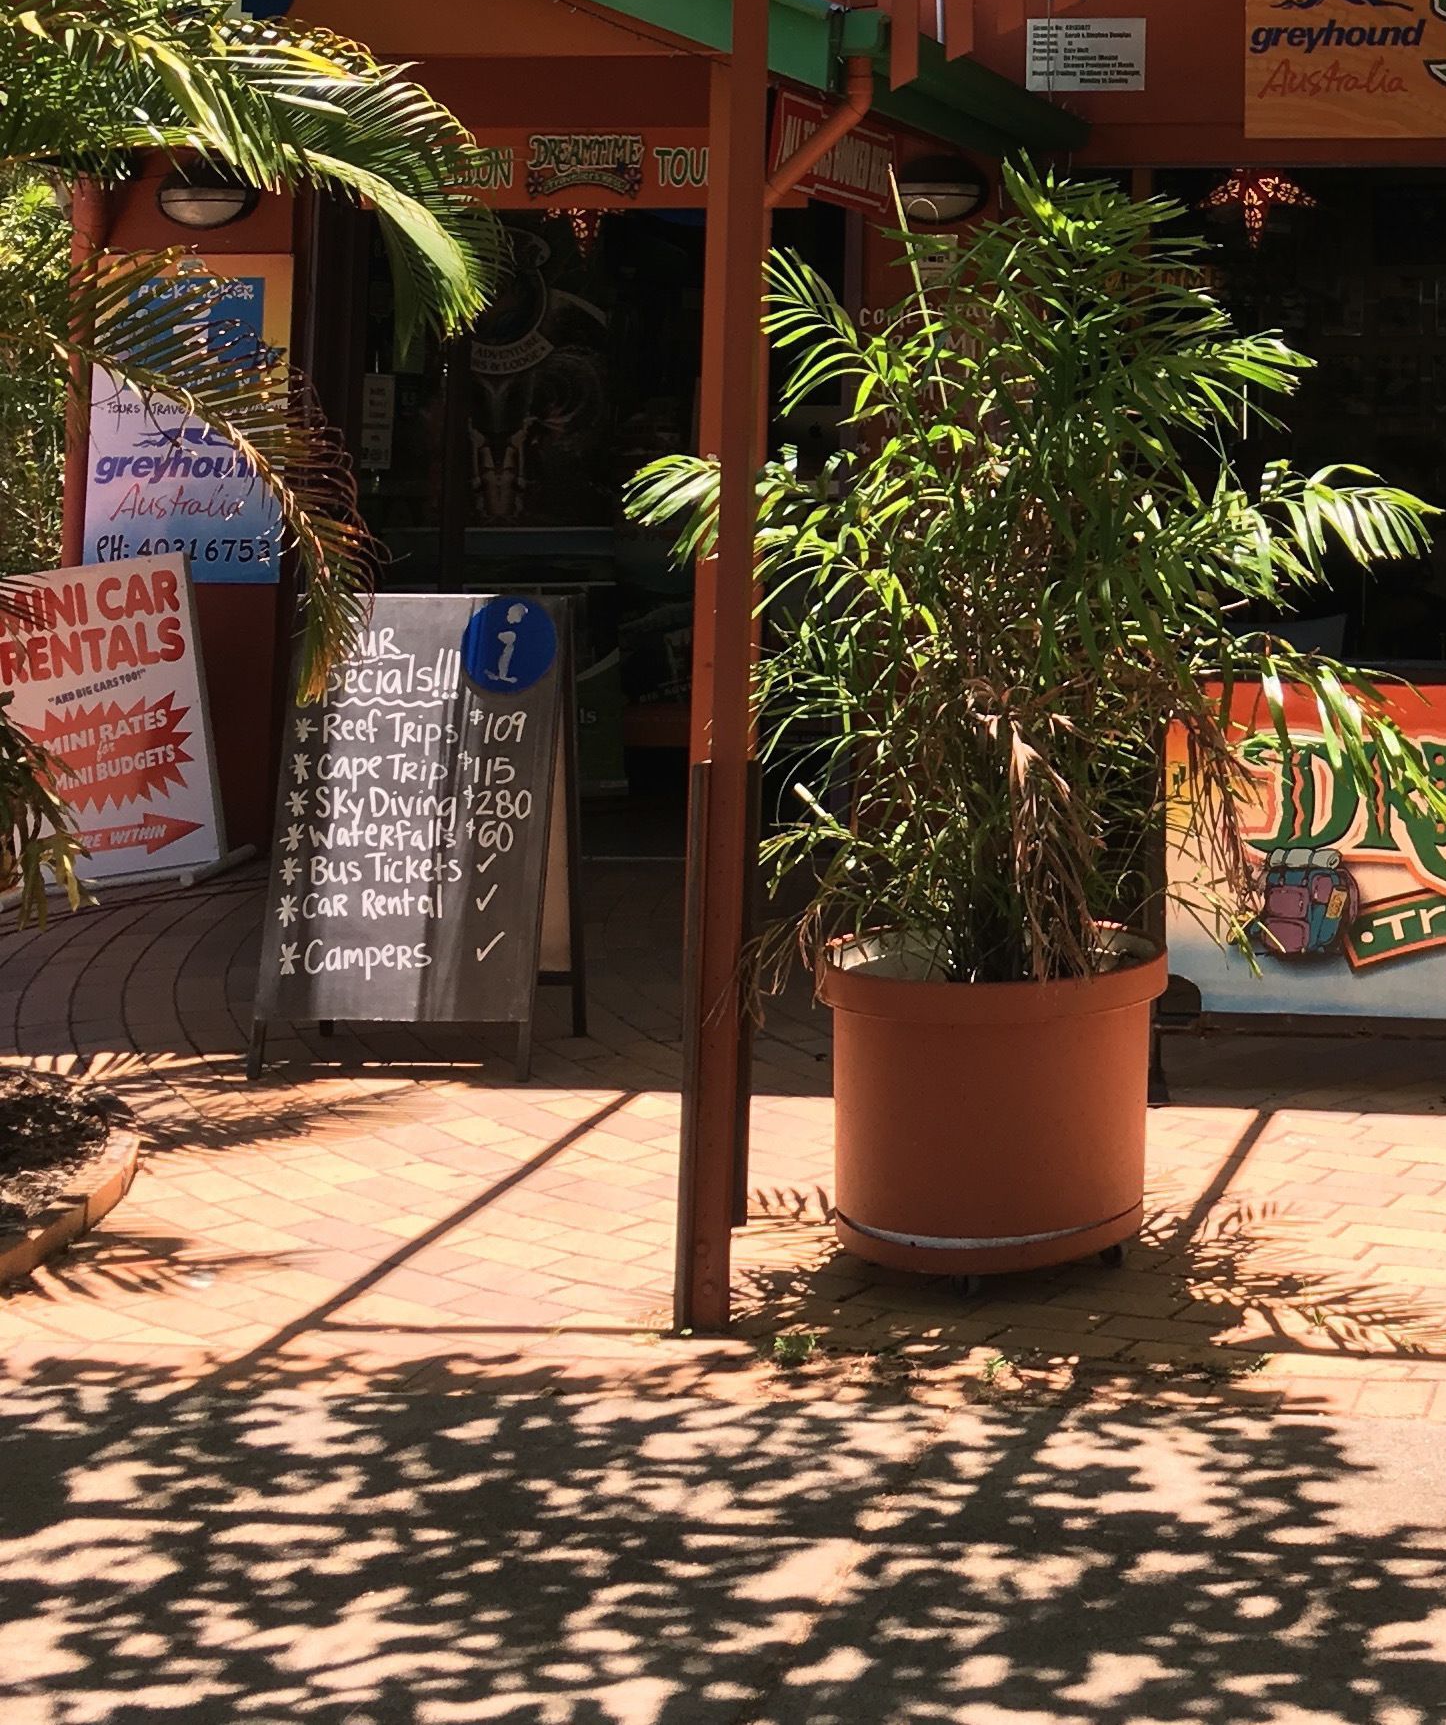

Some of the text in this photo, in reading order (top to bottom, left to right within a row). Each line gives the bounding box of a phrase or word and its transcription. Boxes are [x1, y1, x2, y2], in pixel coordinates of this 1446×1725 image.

[1250, 19, 1426, 54] greyhound
[1258, 56, 1408, 99] Australia
[527, 134, 643, 176] DREAMTIME
[653, 147, 710, 188] TOU
[107, 402, 187, 415] TOURS TRAVE
[110, 482, 244, 521] Australia
[96, 569, 180, 620] CAR
[0, 616, 185, 686] RENTALS
[76, 684, 93, 697] BIG
[94, 677, 118, 692] CARS
[297, 648, 461, 708] pecials!!!
[43, 708, 168, 756] MINI RATES
[322, 708, 382, 744] Reef
[470, 710, 528, 744] $109
[96, 744, 176, 779] BUDGETS
[316, 753, 379, 791] Cape
[458, 751, 516, 785] $115
[370, 788, 457, 832] Diving
[463, 785, 532, 820] $280
[110, 825, 168, 845] WITHIN
[466, 820, 513, 853] $60
[311, 851, 462, 885] Bus Tickets
[361, 884, 443, 920] Rental
